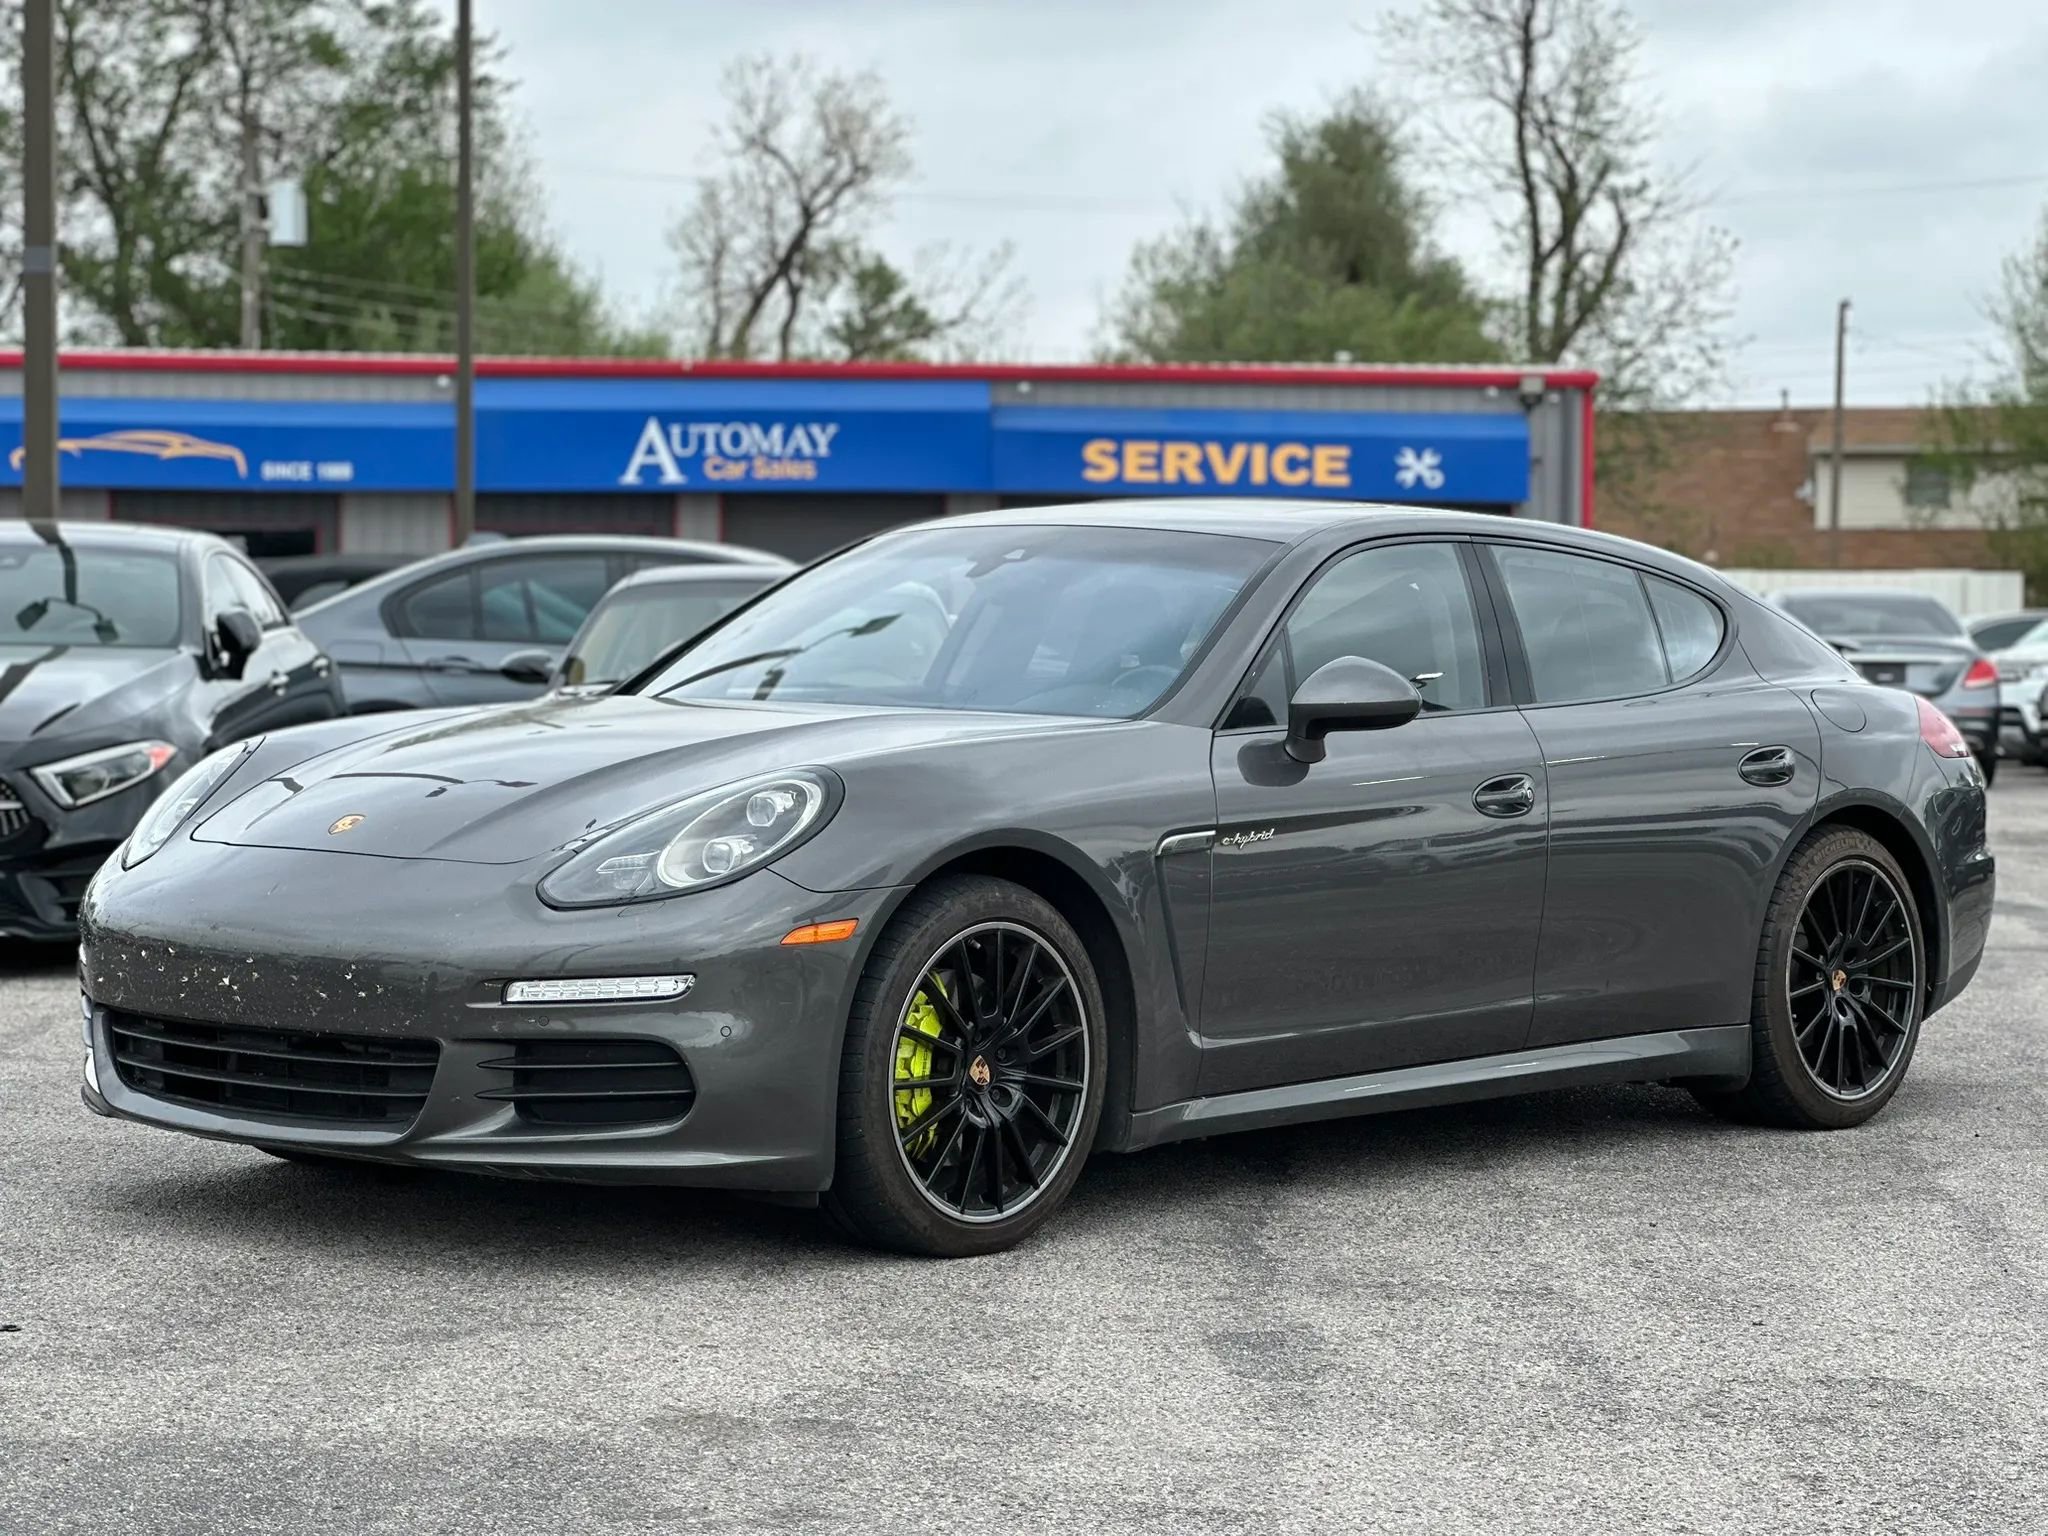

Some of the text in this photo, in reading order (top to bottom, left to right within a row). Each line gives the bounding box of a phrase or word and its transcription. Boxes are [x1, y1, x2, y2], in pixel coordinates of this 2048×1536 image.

[619, 416, 838, 485] AUTOMAY
[704, 456, 817, 480] Car Sales
[1082, 439, 1351, 487] SERVICE
[1813, 837, 1857, 864] MICHELIN
